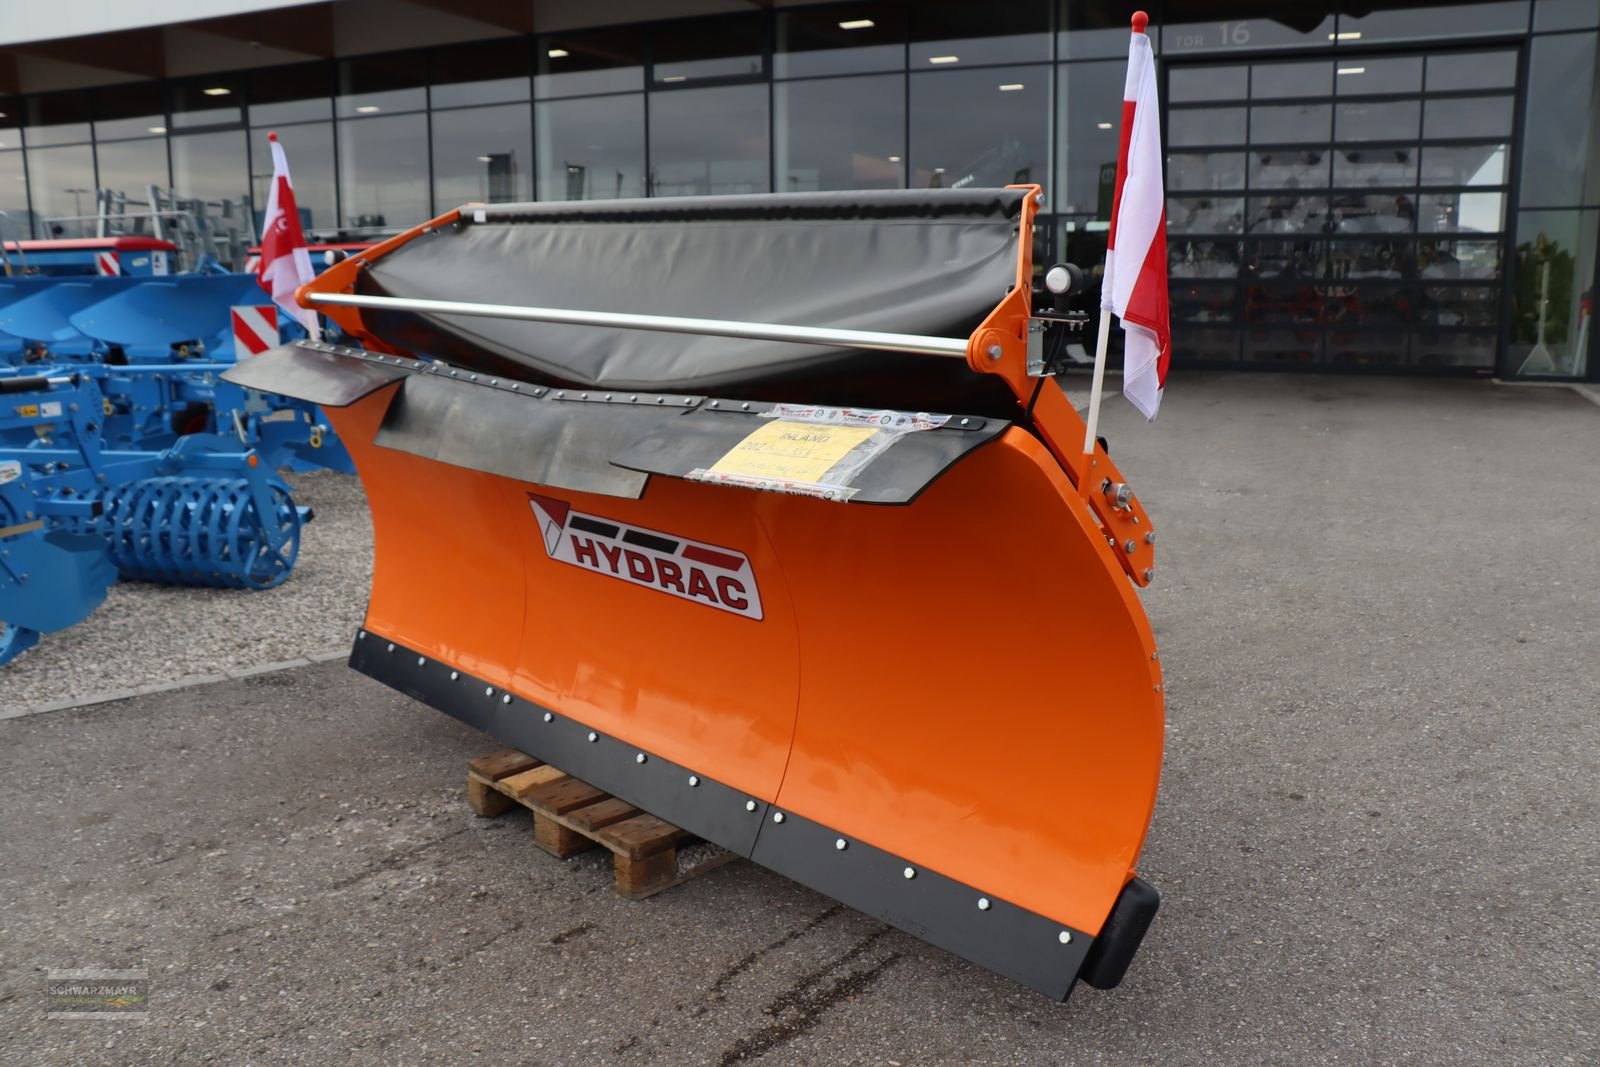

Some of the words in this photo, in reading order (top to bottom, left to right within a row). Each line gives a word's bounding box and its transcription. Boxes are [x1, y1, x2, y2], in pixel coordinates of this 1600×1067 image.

[1175, 35, 1204, 47] TOR
[1220, 21, 1250, 45] 16
[779, 431, 831, 443] INLAND
[570, 534, 748, 610] HYDRAC
